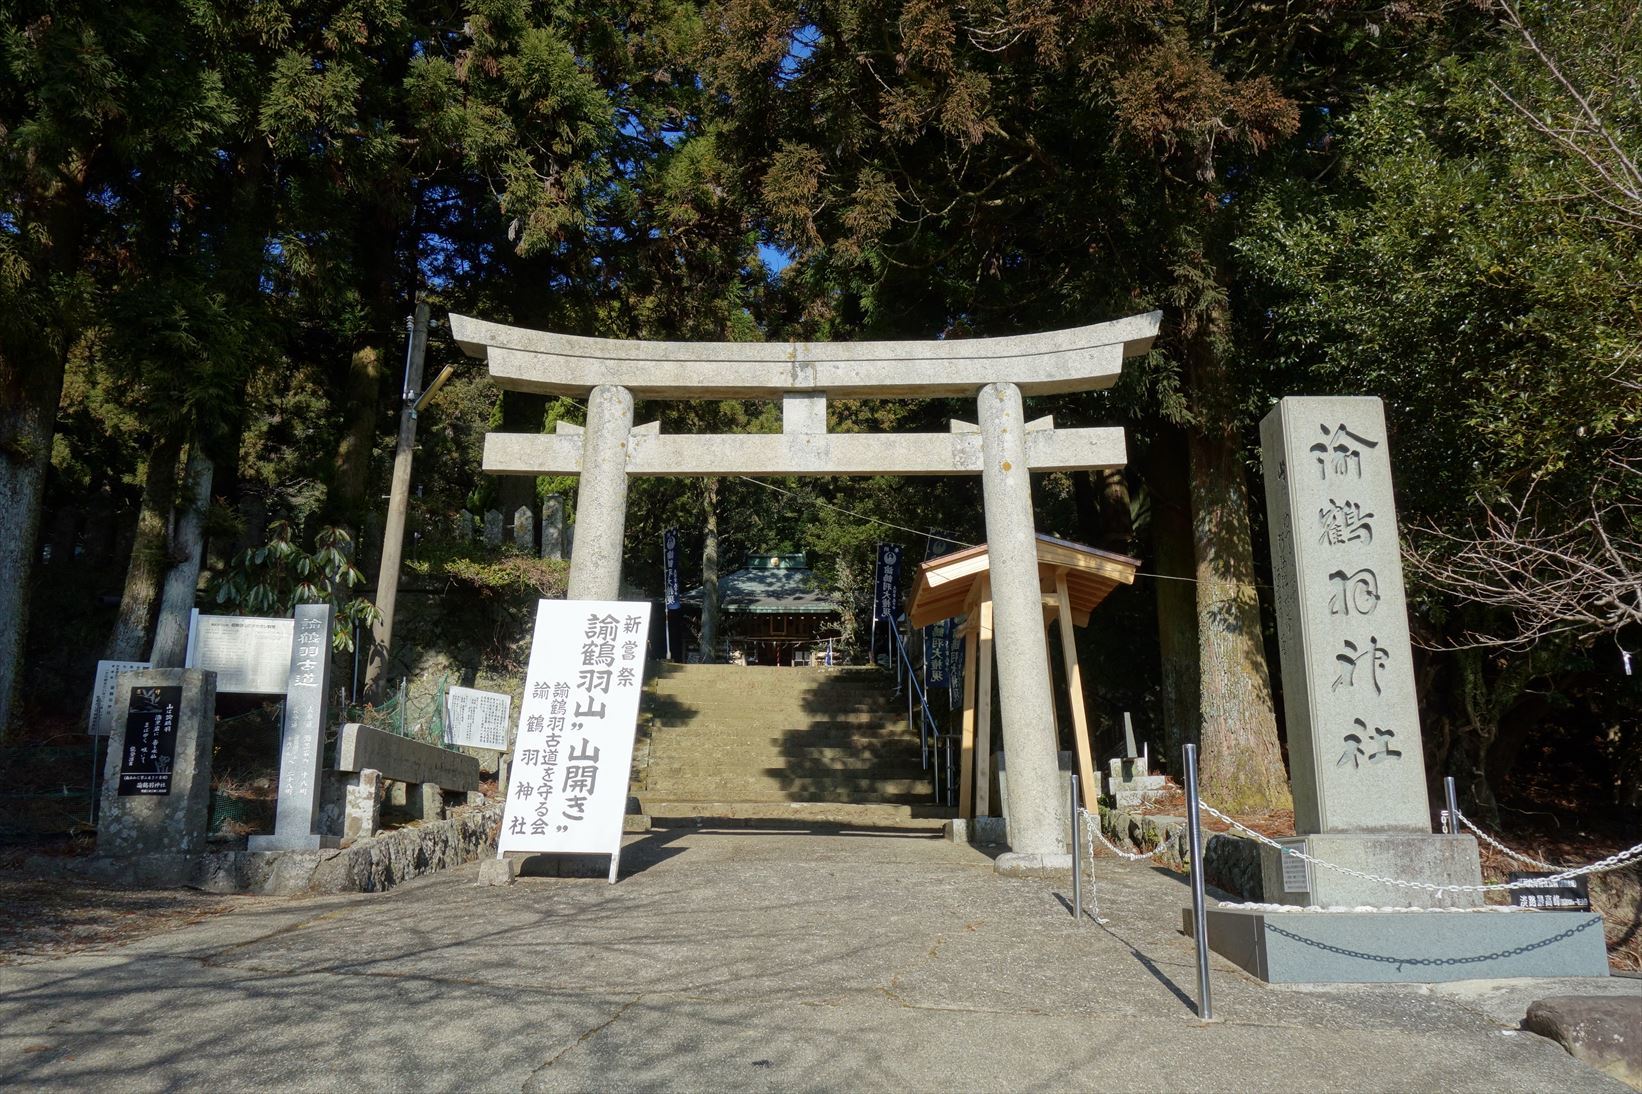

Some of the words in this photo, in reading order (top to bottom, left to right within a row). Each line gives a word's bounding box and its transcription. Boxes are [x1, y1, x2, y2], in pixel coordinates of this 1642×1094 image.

[293, 618, 322, 687] 諭鶴羽古道
[617, 614, 642, 688] 新嘗祭
[508, 681, 551, 836] 諭鶴羽神社
[530, 681, 571, 836] 諭鶴羽古道を守る会
